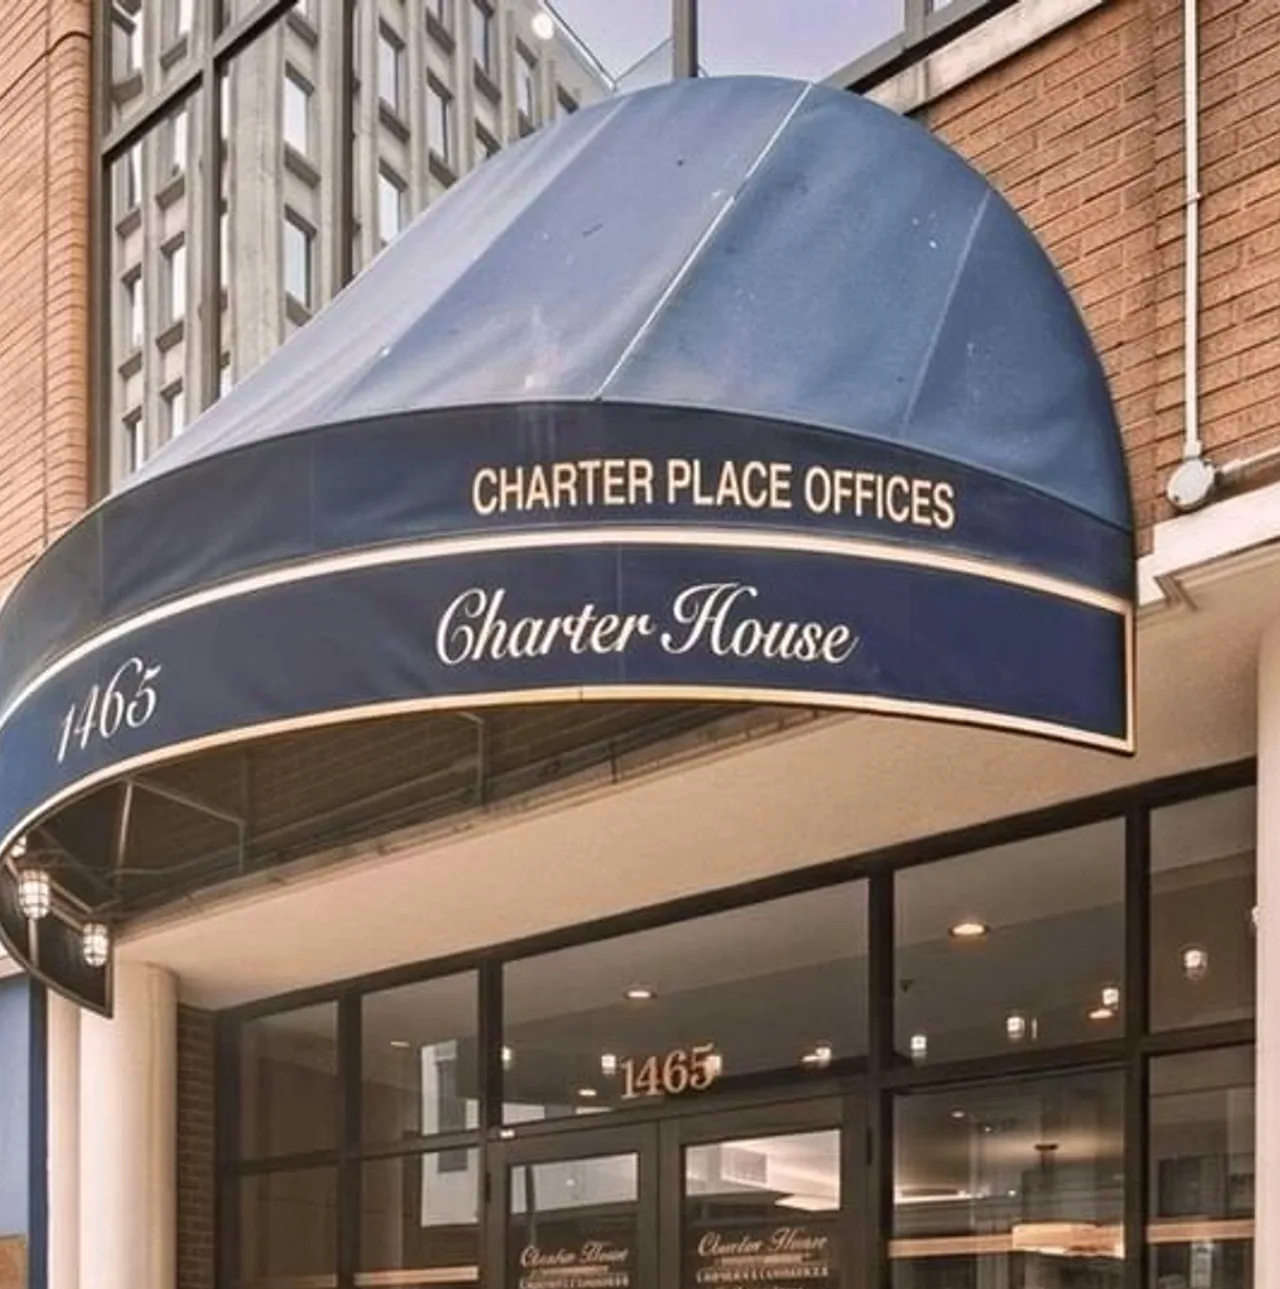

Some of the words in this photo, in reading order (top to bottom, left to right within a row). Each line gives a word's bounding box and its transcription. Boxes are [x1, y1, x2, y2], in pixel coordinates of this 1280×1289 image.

[472, 460, 654, 512] CHARTER
[666, 459, 793, 509] PLACE
[805, 466, 956, 529] OFFICES
[435, 588, 656, 664] Charter
[662, 581, 859, 664] House
[58, 658, 162, 763] 1465
[621, 1043, 715, 1099] 1465
